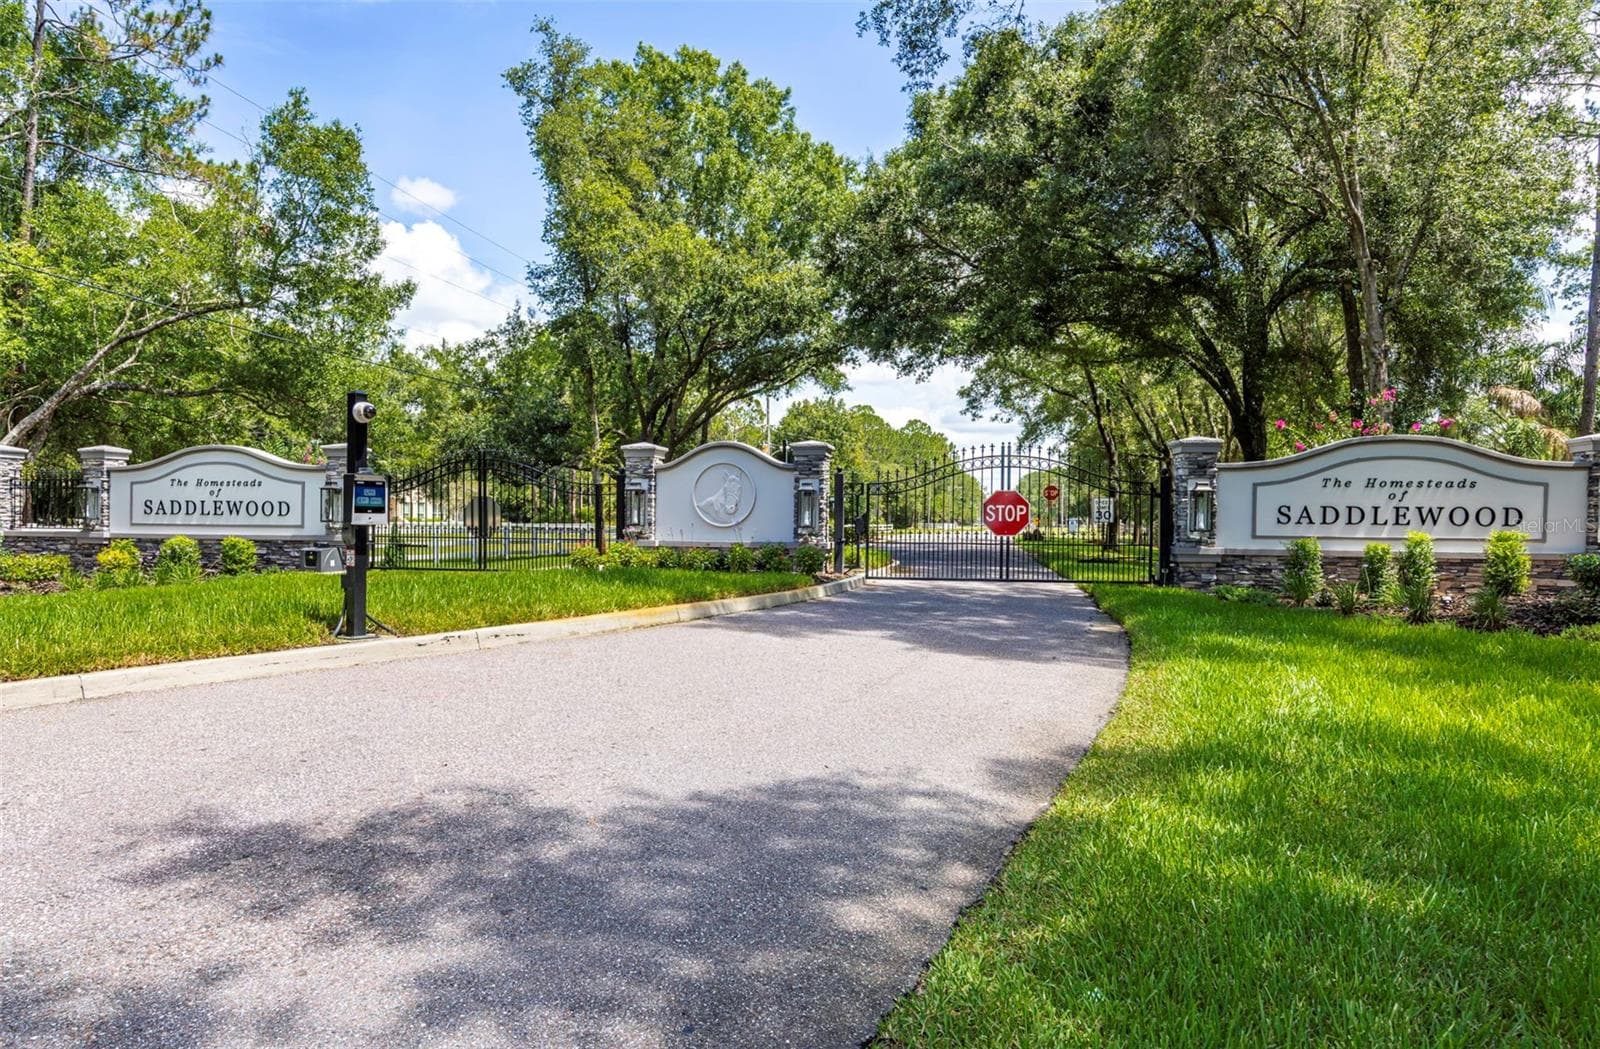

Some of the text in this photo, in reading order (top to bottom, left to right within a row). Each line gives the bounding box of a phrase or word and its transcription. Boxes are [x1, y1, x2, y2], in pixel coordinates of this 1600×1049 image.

[170, 478, 263, 487] The Homesteads
[1322, 477, 1479, 489] The Homesteads
[209, 488, 222, 498] of
[1388, 489, 1408, 502] of
[143, 499, 291, 517] SADDLEWOOD
[986, 504, 1027, 522] STOP
[1095, 510, 1112, 520] 30
[1276, 505, 1524, 527] SADDLEWOOD
